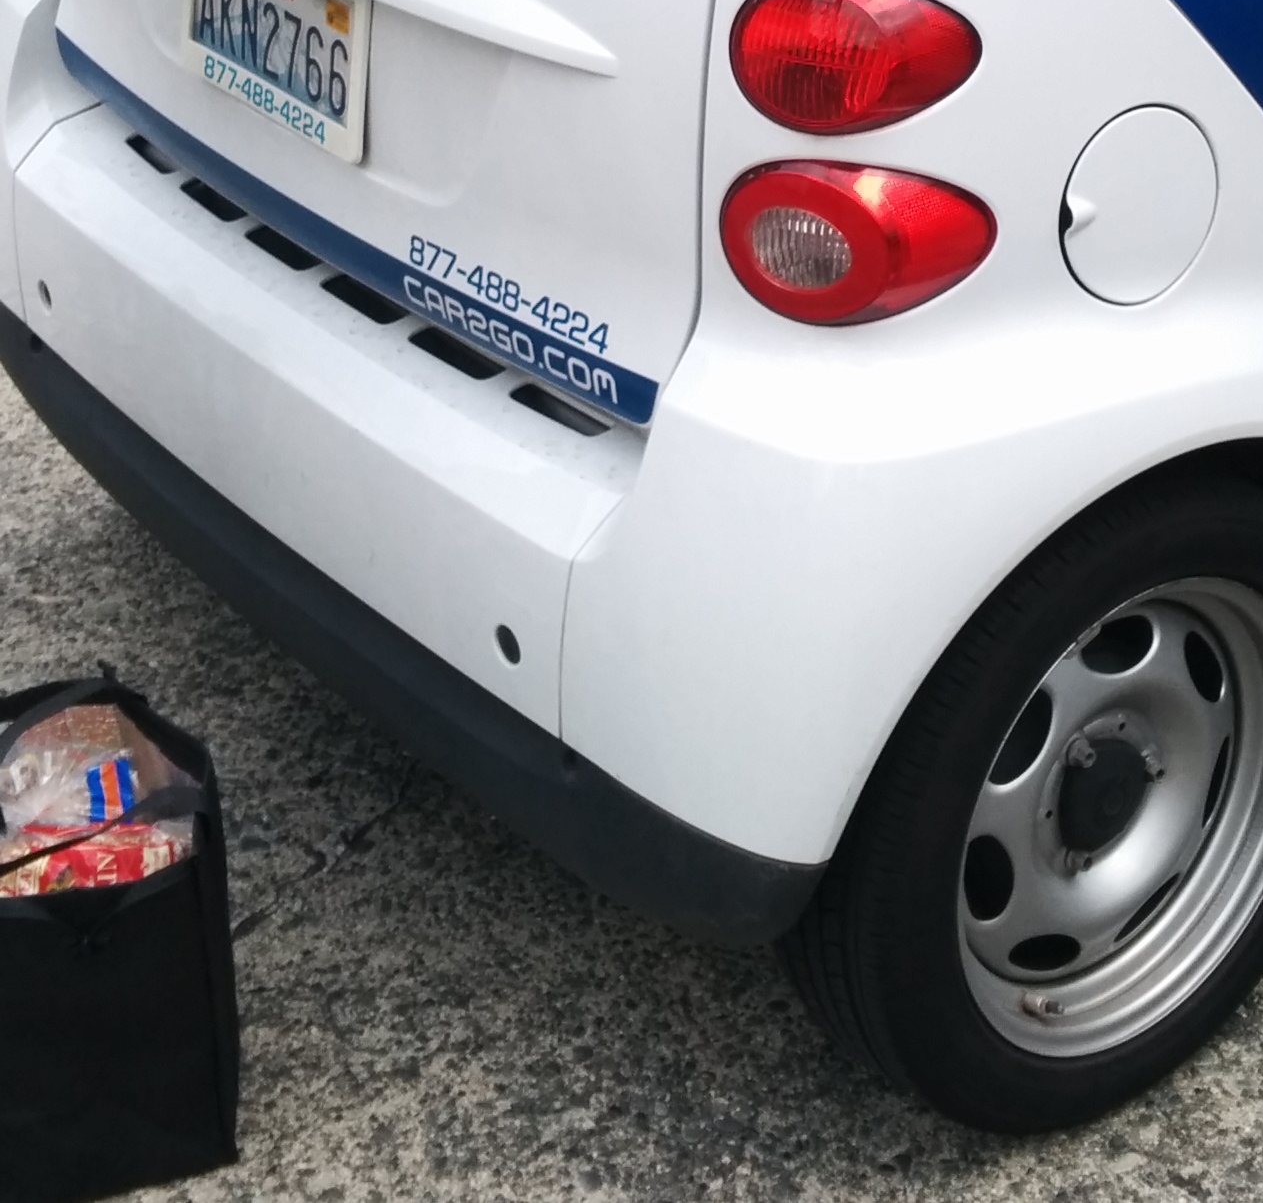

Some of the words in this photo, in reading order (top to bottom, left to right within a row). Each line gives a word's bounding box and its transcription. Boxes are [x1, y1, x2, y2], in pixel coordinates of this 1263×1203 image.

[204, 54, 326, 144] 877-488-4224
[403, 275, 618, 405] CAR2GO.COM
[409, 234, 609, 354] 877-488-4224
